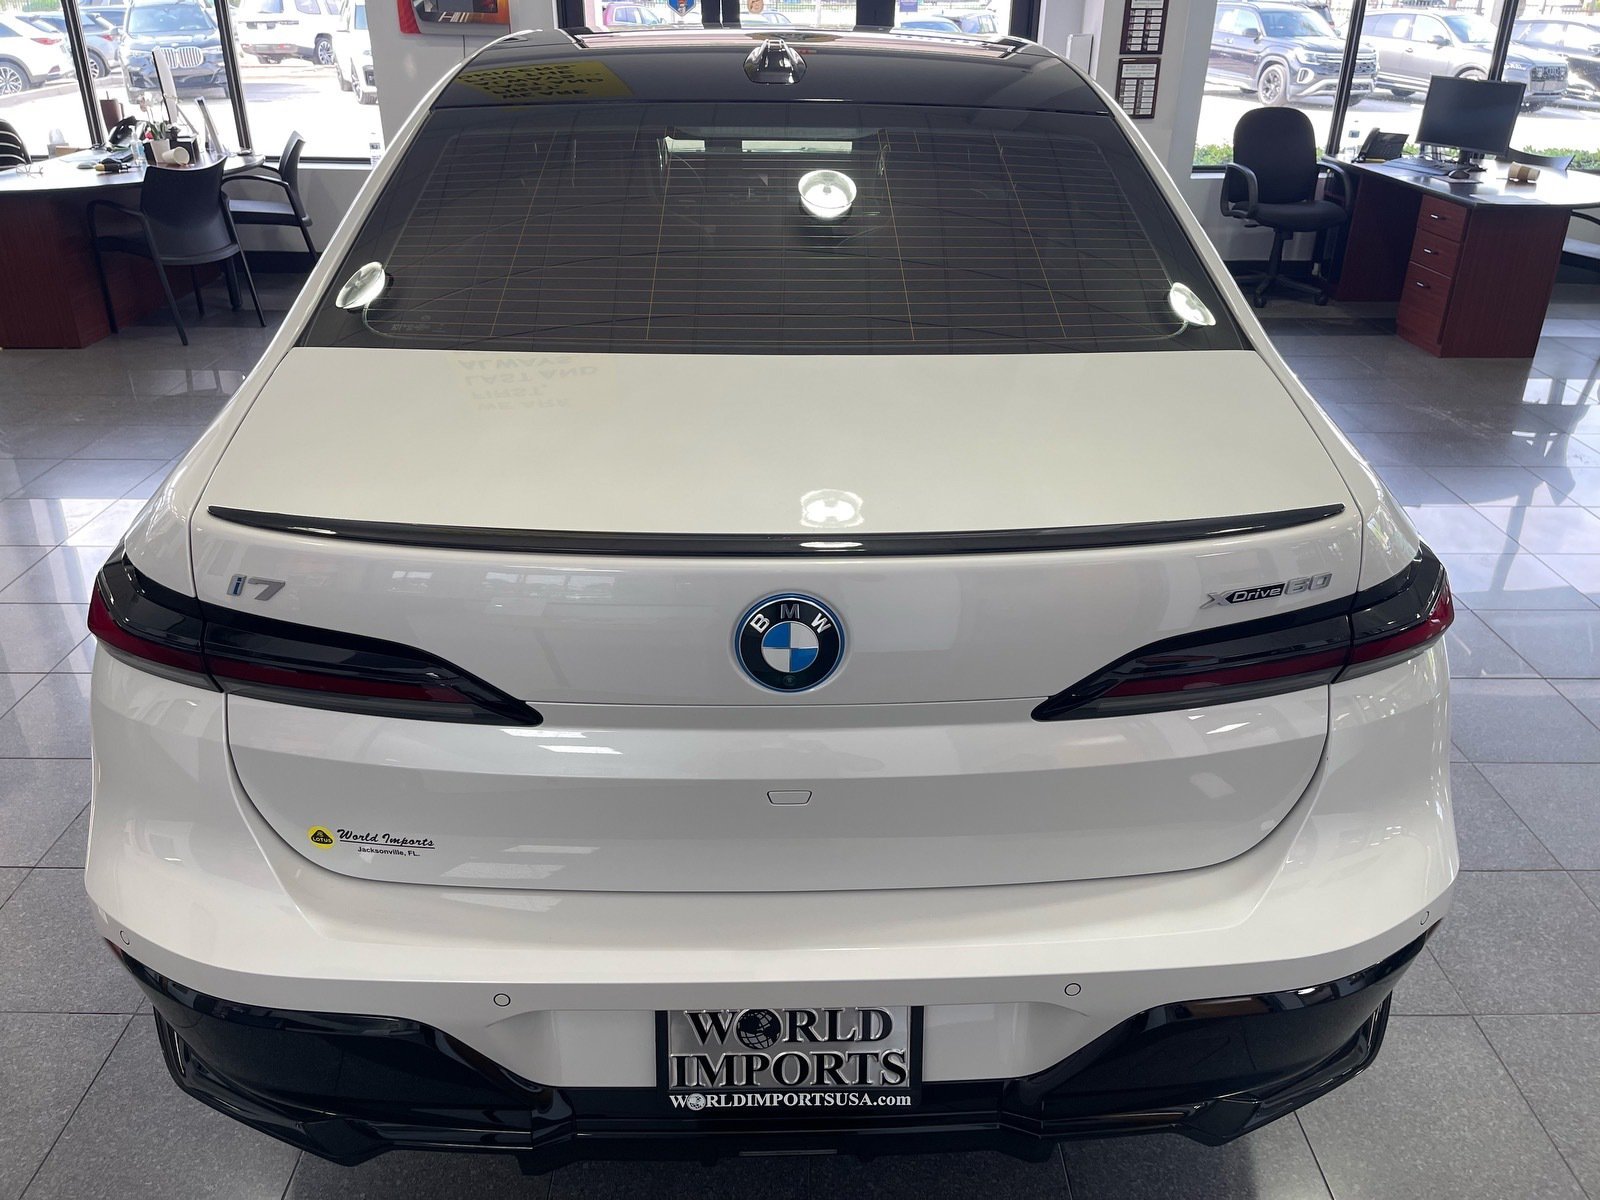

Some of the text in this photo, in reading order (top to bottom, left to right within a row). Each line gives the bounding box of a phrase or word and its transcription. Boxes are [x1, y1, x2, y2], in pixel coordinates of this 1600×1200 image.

[227, 574, 286, 601] i7
[749, 603, 832, 634] BMW
[312, 836, 332, 844] LOTUS
[337, 829, 435, 847] World Imports
[357, 846, 407, 857] Jacksonville,
[670, 1048, 909, 1087] IMPORTS
